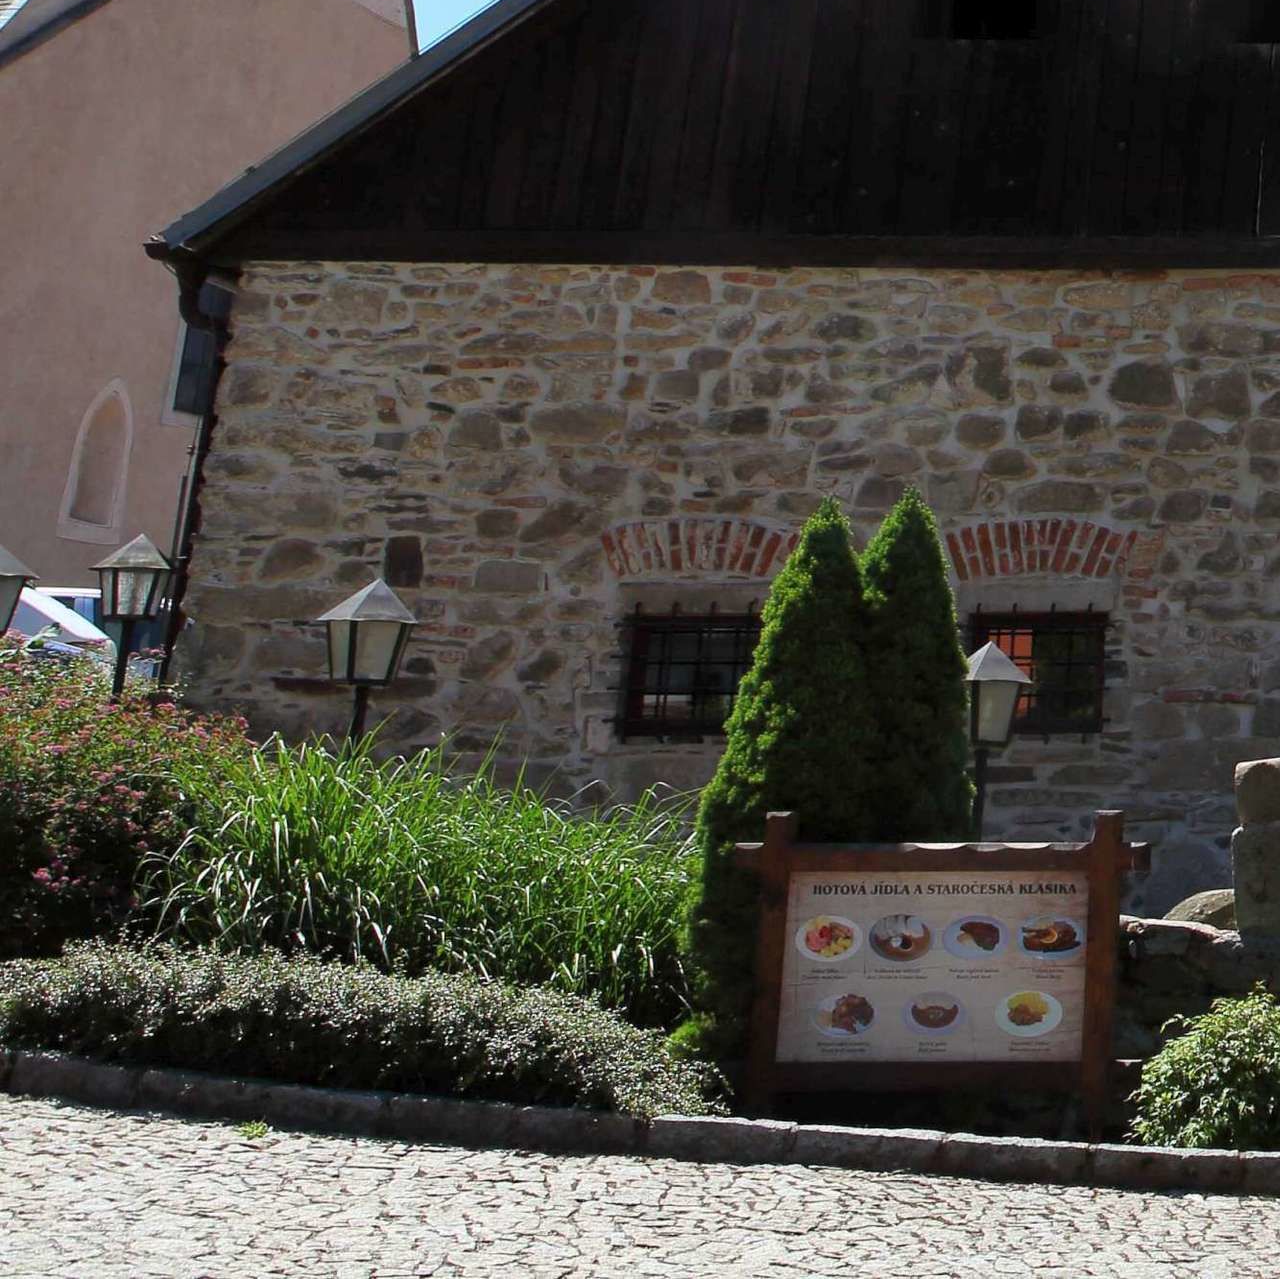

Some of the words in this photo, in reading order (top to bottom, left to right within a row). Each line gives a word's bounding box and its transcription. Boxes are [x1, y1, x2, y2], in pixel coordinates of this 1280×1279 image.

[813, 879, 867, 895] HOTOVÁ
[870, 879, 910, 895] JÍDLA
[914, 884, 923, 895] A
[927, 879, 1014, 895] STAROČESKÁ
[1018, 882, 1077, 894] KLASIKA
